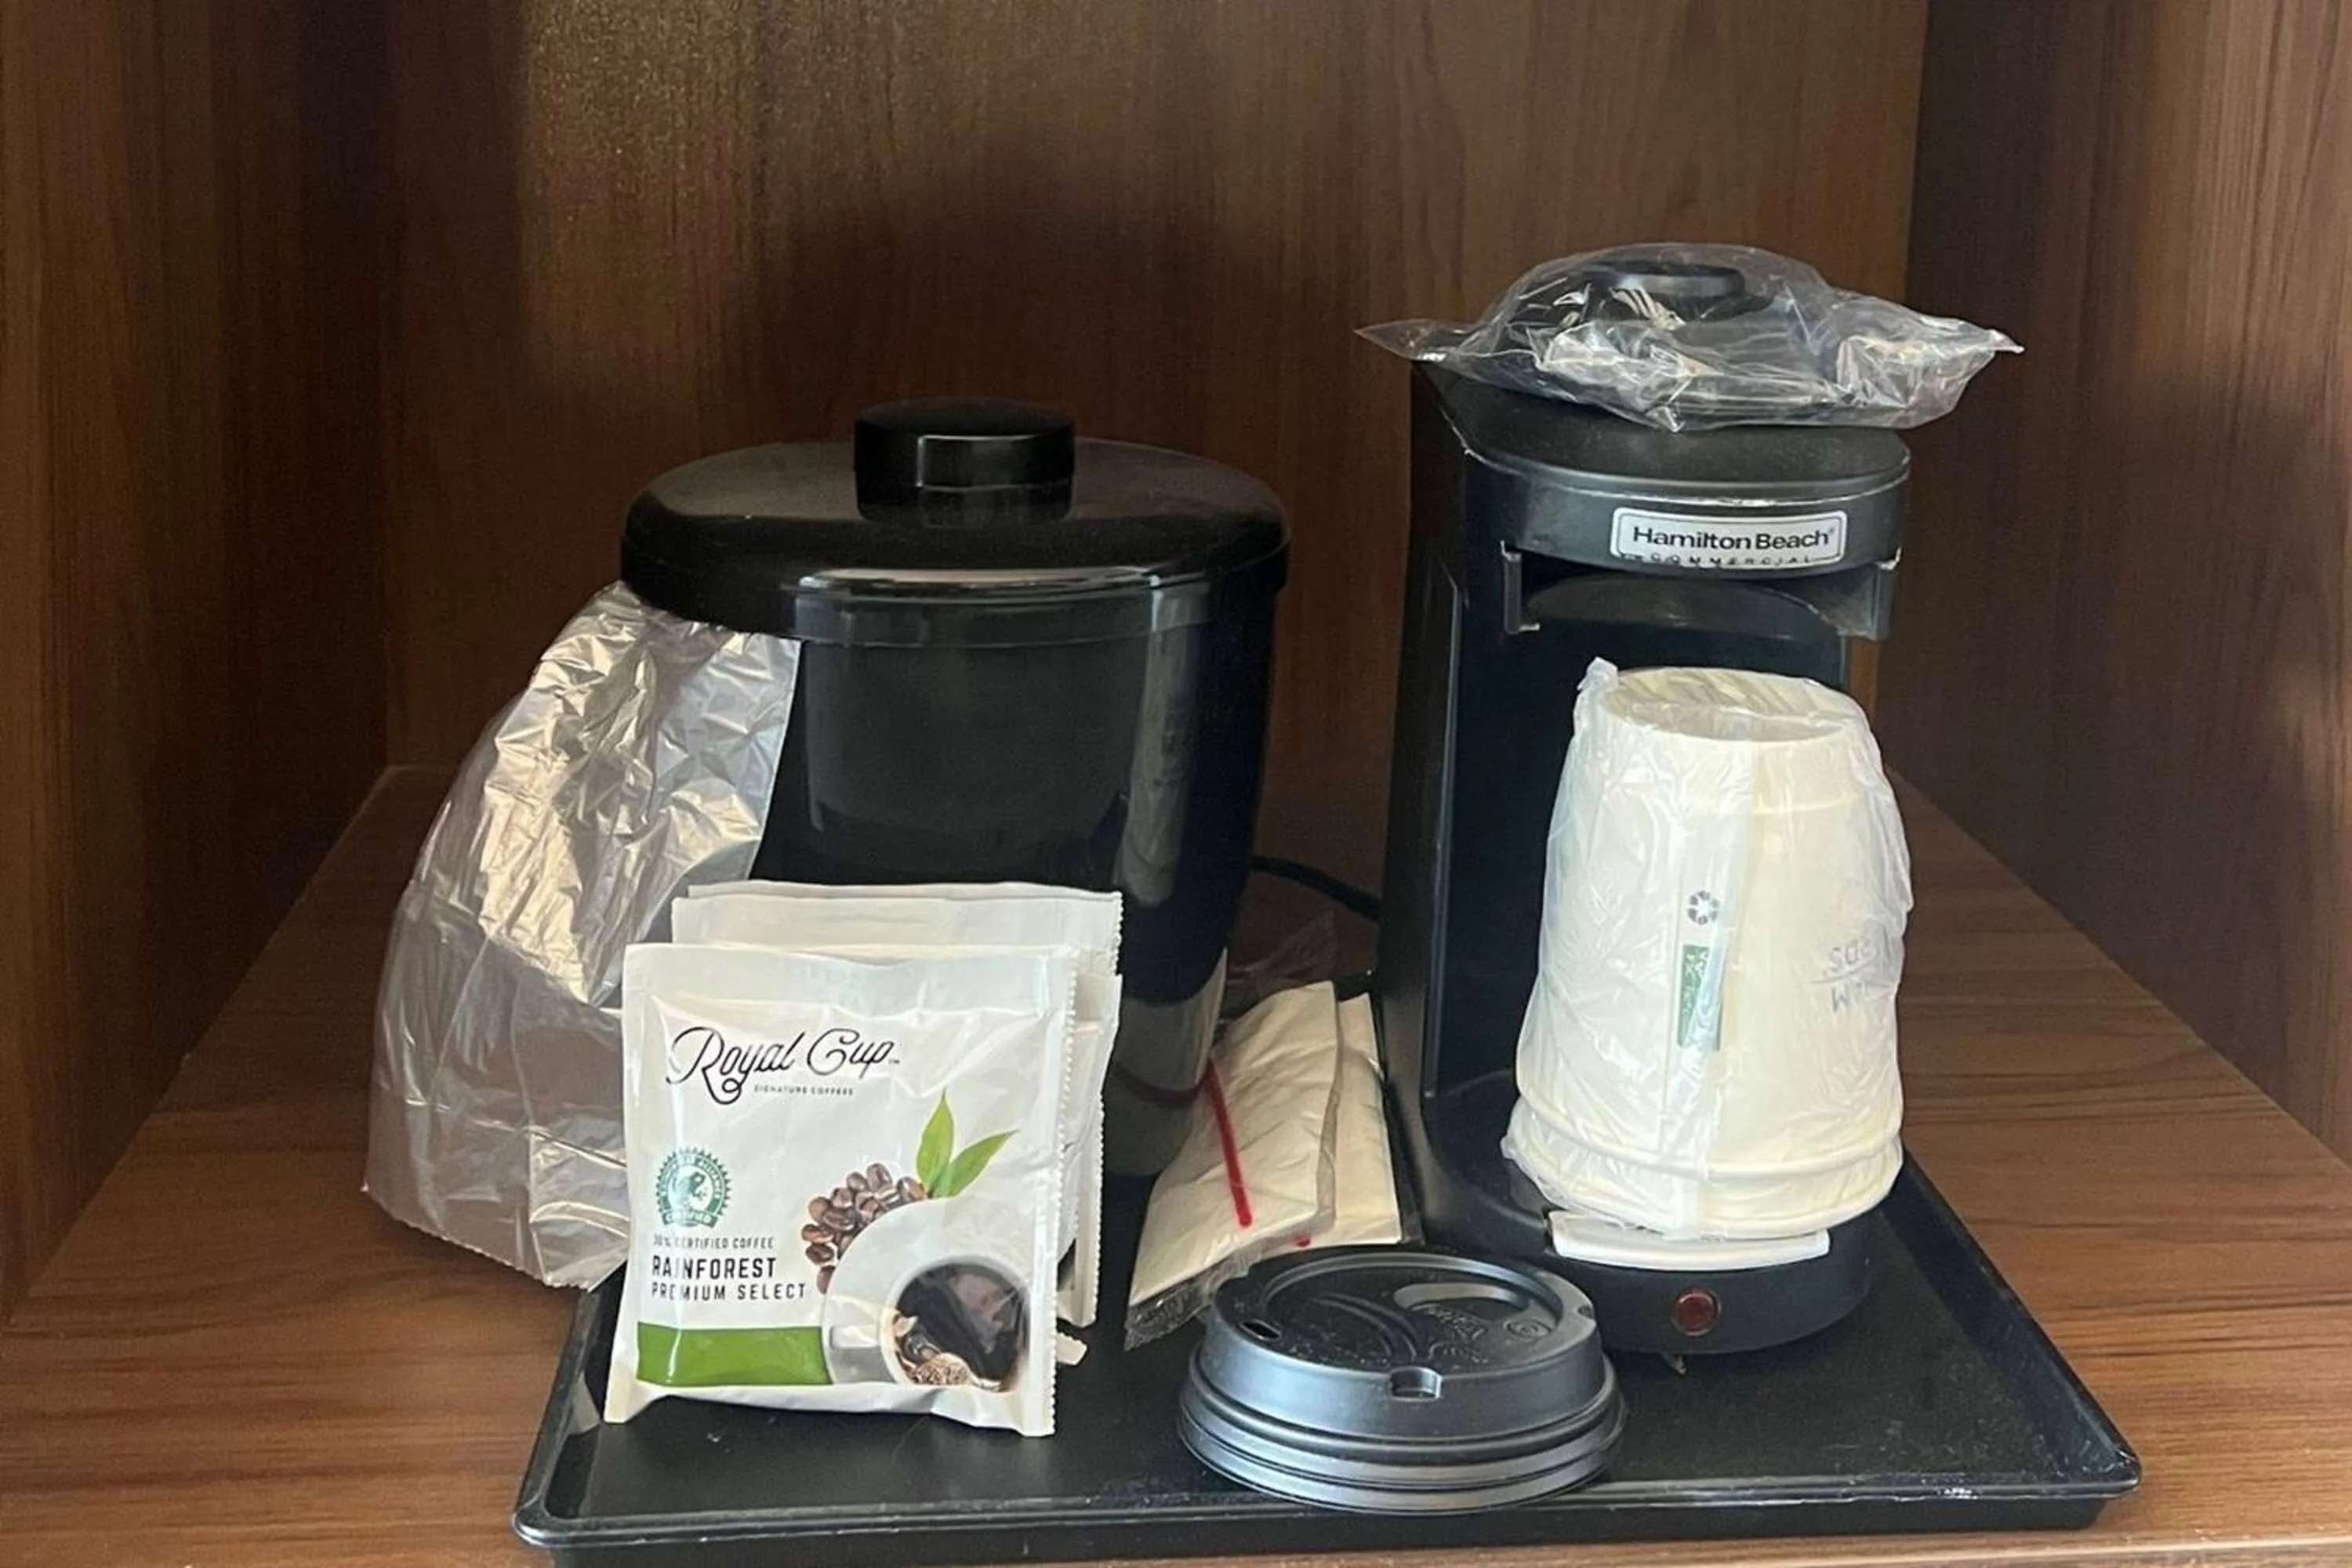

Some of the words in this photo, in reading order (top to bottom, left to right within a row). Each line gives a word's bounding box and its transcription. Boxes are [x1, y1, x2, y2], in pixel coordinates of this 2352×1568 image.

[1633, 526, 1751, 550] Hamilton
[1755, 529, 1829, 550] Beach
[666, 1026, 806, 1105] Royal
[807, 1027, 895, 1080] Cup
[753, 1083, 808, 1095] SIGNATURE
[732, 1236, 775, 1250] COFFEE
[652, 1254, 777, 1280] RAINFOREST
[652, 1281, 726, 1301] PREMIUM
[737, 1283, 806, 1301] SELECT
